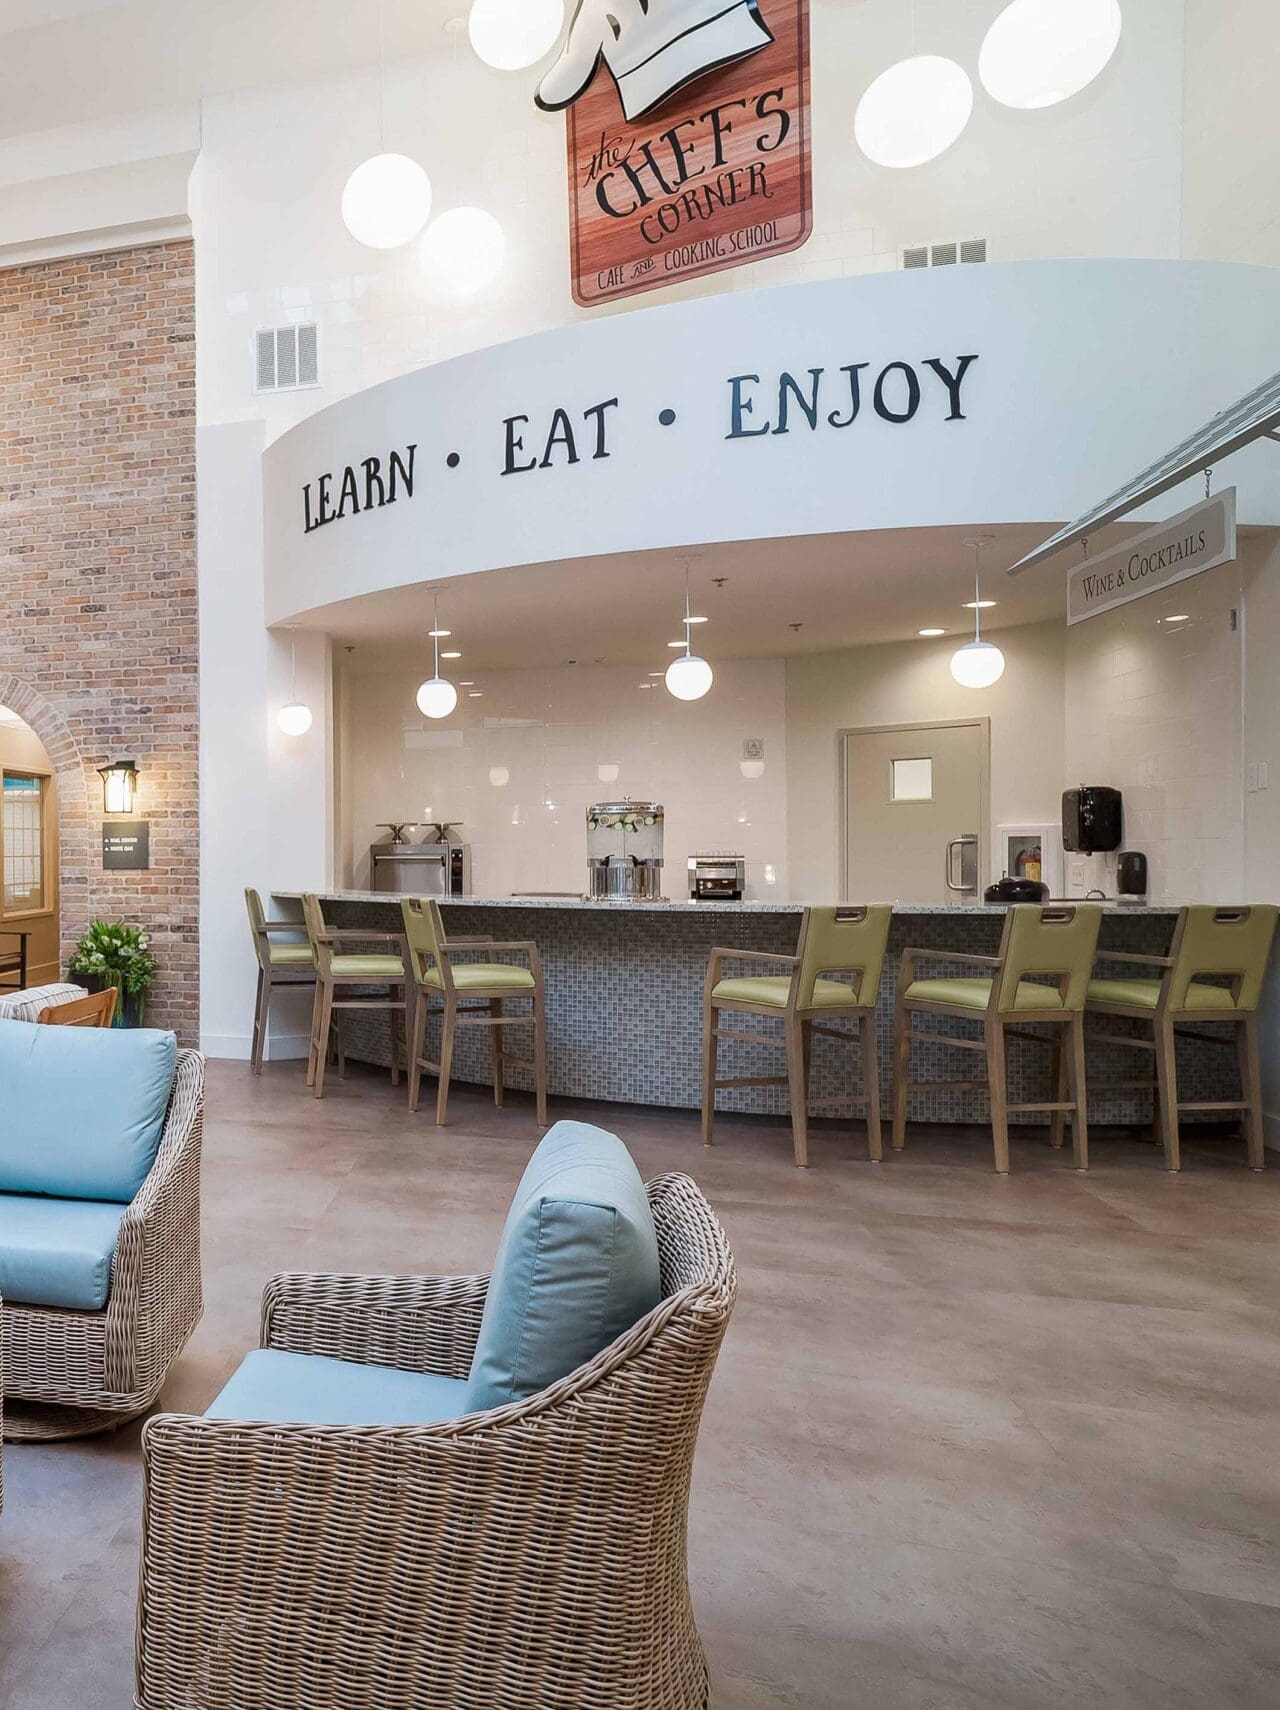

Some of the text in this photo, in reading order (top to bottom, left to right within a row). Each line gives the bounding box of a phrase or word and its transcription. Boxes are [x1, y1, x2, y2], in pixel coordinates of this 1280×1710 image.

[580, 131, 636, 188] the
[640, 161, 774, 244] CORNER
[597, 221, 780, 291] CAFE AND COOKING SCHOOL
[302, 353, 980, 534] LEARN EAT ENJOY
[1116, 568, 1126, 588] &
